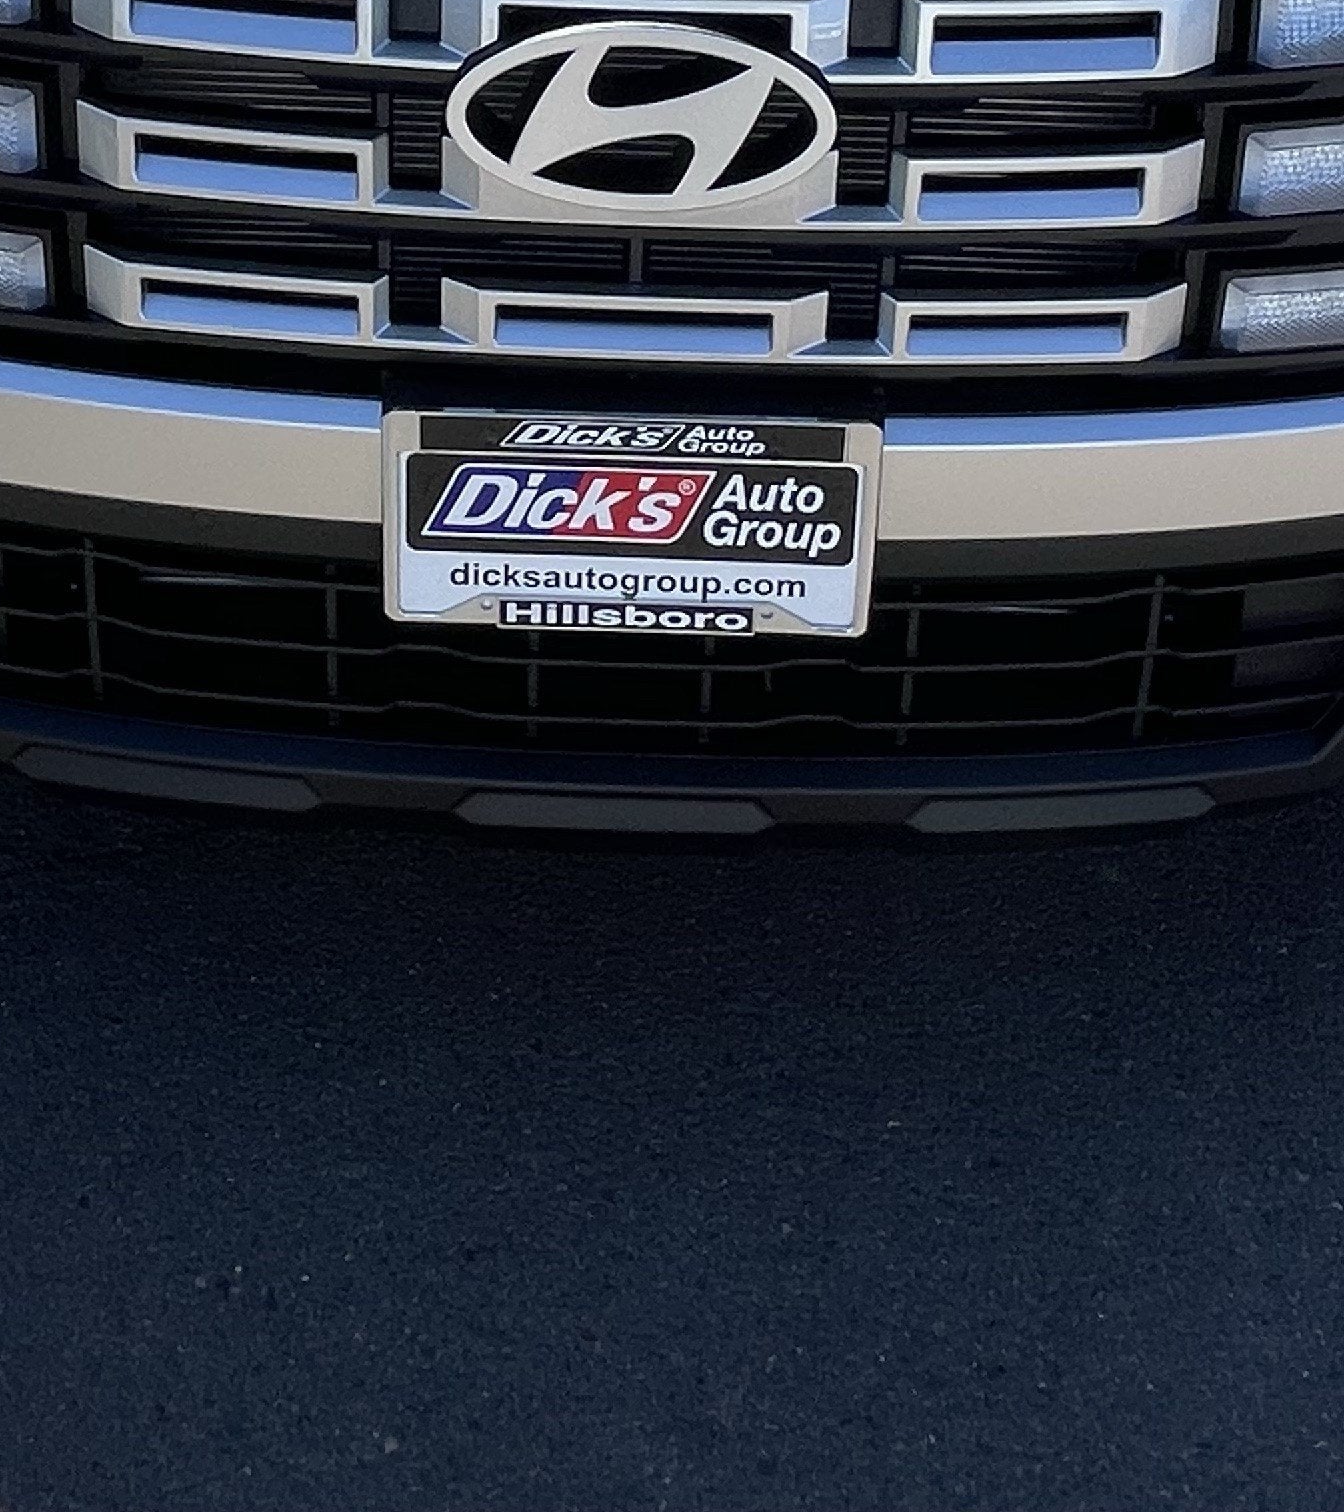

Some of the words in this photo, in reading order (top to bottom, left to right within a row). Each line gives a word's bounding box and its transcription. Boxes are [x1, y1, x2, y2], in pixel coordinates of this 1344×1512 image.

[514, 423, 665, 447] Dick's
[687, 425, 755, 441] Auto
[677, 439, 766, 457] Group
[442, 473, 680, 531] Dick's
[712, 475, 824, 514] Auto
[702, 511, 842, 558] Group
[449, 562, 807, 602] dicksautogroup.com
[504, 600, 749, 630] Hillsboro
